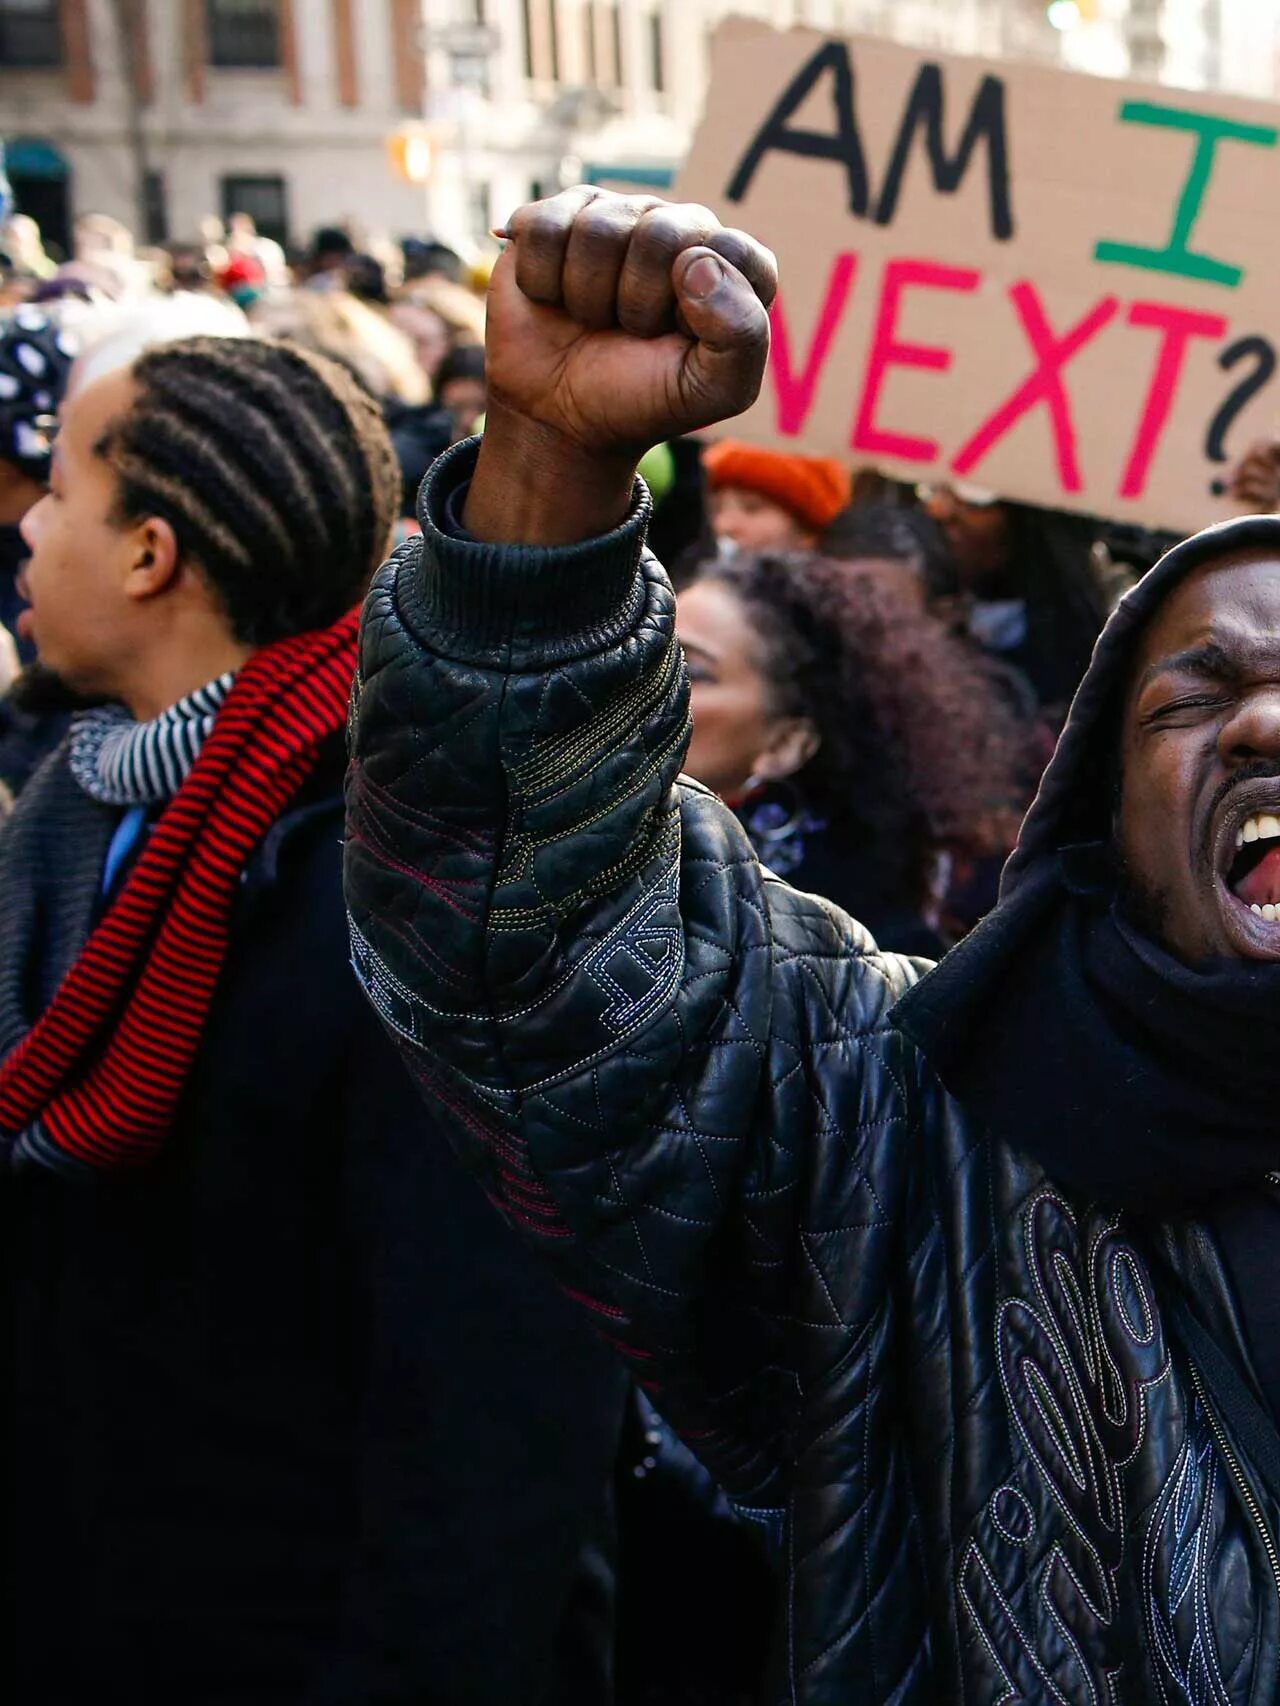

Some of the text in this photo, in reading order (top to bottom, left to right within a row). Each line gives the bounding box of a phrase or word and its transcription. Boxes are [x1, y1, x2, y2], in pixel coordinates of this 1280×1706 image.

[724, 39, 1280, 288] AM I
[768, 250, 1278, 500] NEXT?
